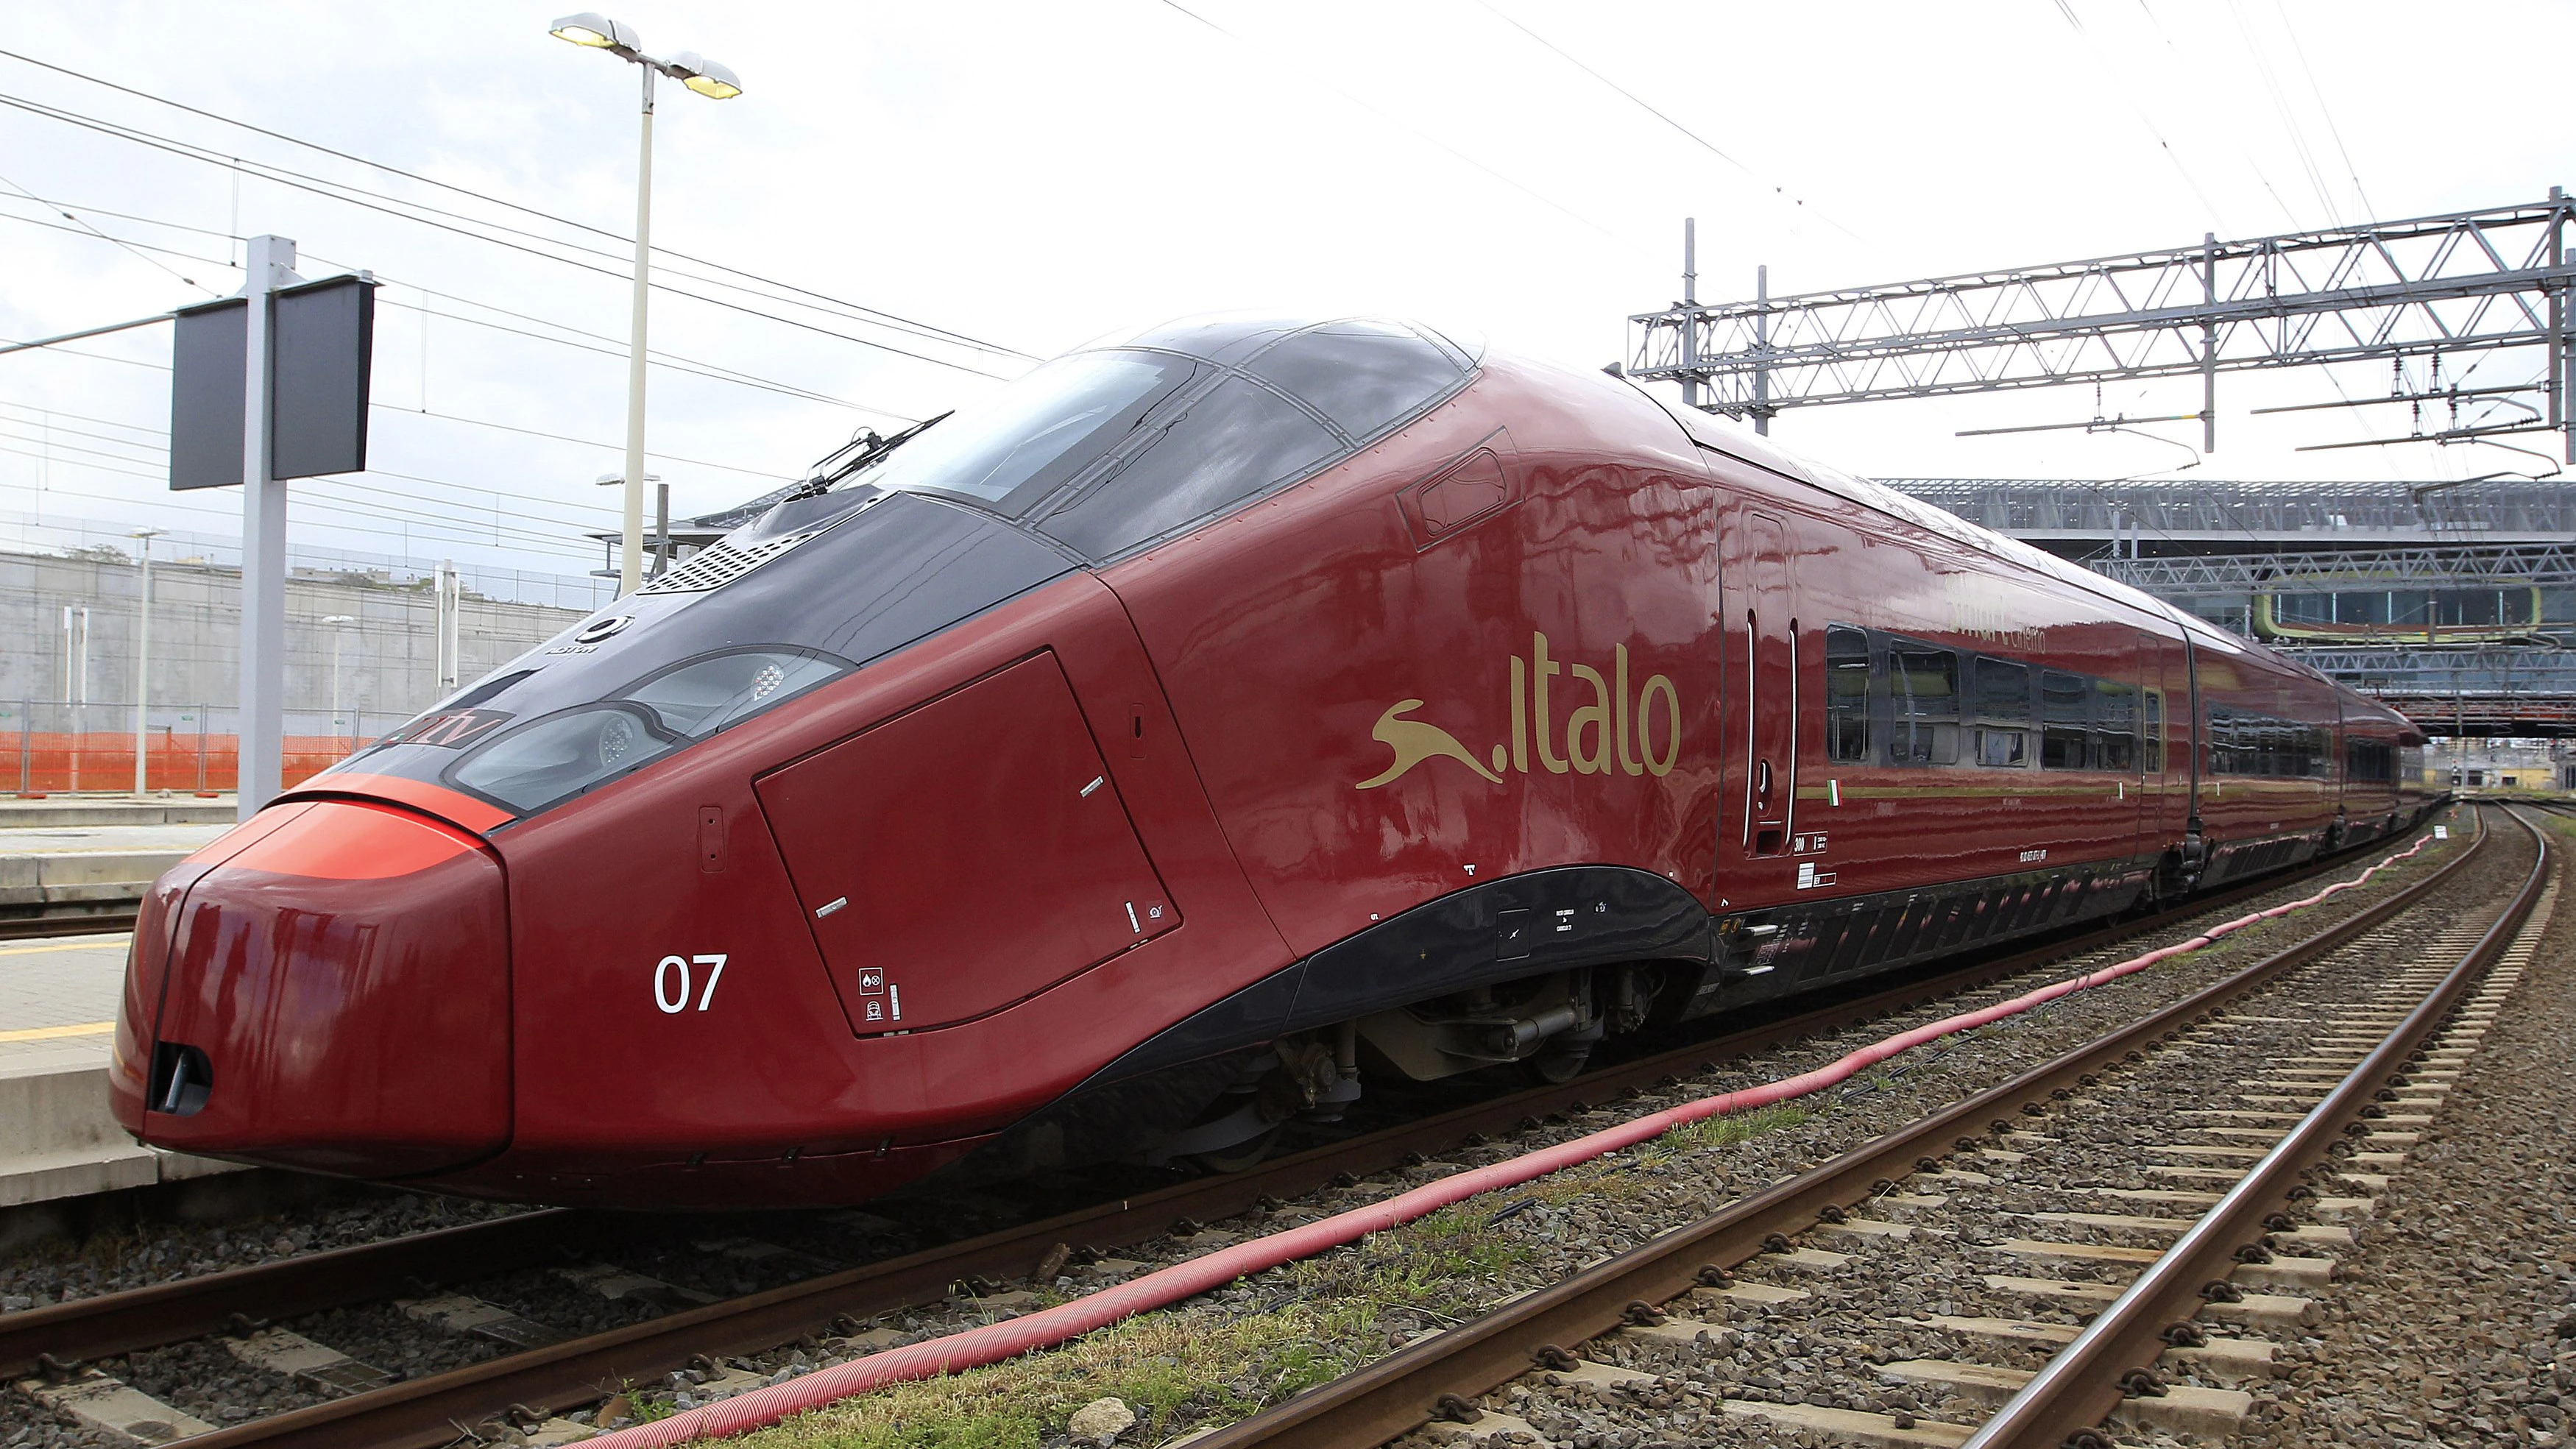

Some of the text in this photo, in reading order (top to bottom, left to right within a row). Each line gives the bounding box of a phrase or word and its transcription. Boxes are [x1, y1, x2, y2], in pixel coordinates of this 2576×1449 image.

[2011, 619, 2046, 654] cinema
[1794, 837, 1805, 852] 300
[654, 954, 728, 1014] 07
